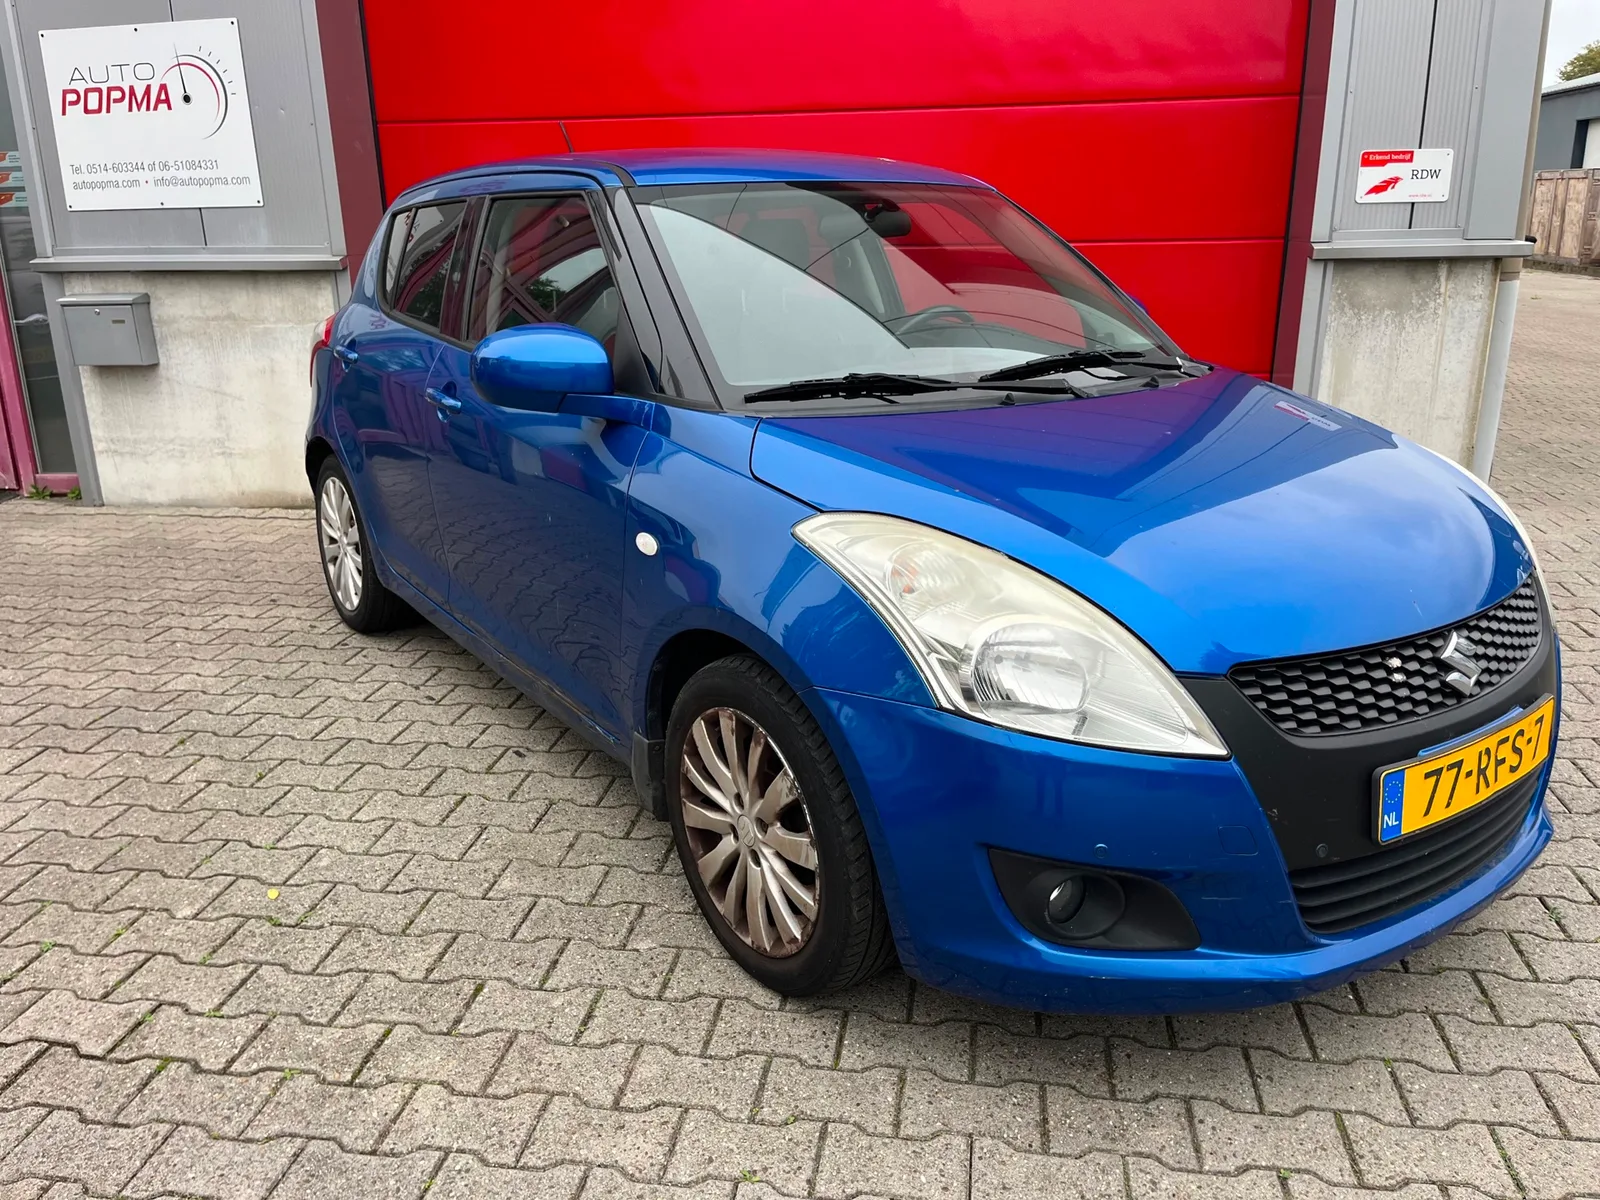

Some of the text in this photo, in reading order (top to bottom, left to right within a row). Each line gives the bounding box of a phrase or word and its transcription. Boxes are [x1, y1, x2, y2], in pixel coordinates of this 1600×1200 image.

[68, 62, 155, 85] AUTO
[61, 83, 172, 116] POPMA
[70, 159, 219, 175] Tel. 0514-603344 of 06-51084331
[1410, 168, 1441, 180] RDW
[72, 175, 251, 191] autopopma.com info@autopopma.com
[1422, 714, 1545, 818] 77-RFS-7
[1383, 811, 1399, 829] NL
